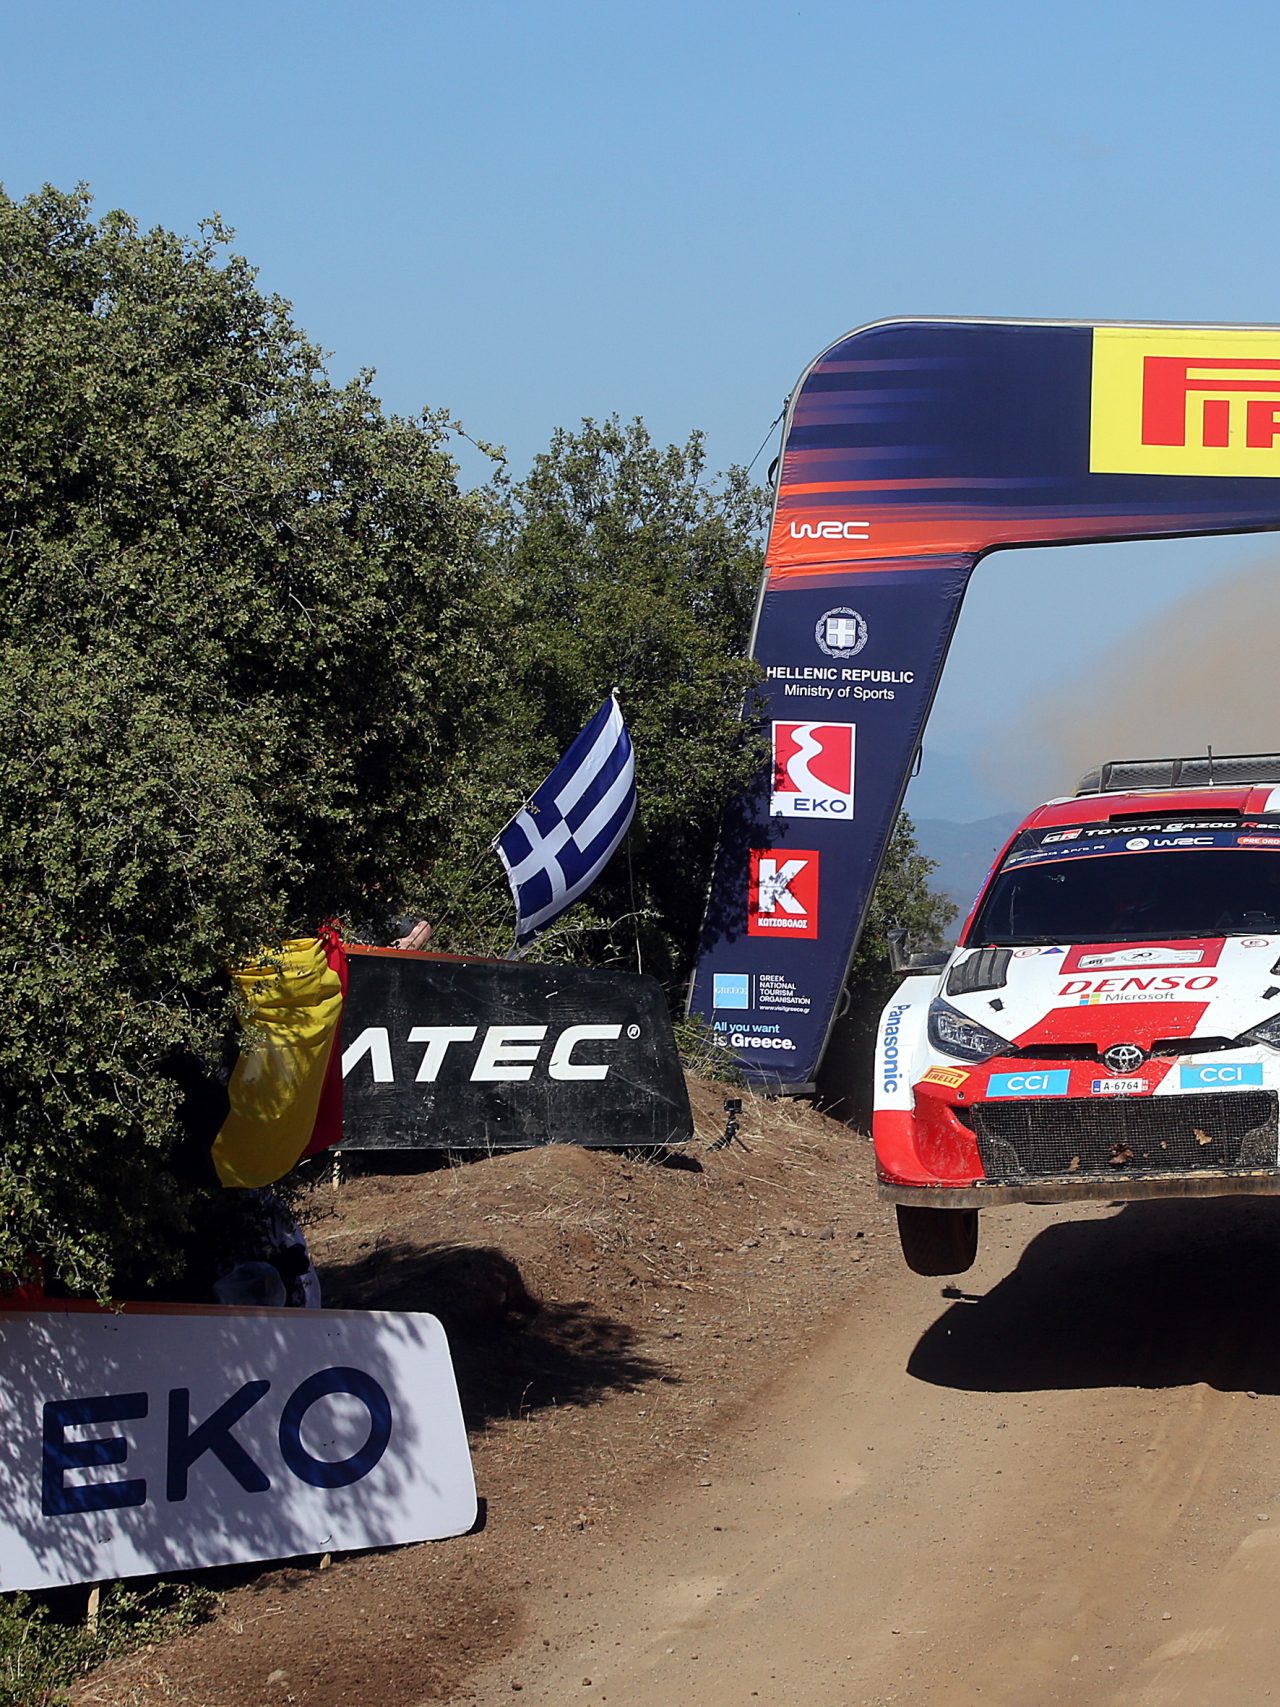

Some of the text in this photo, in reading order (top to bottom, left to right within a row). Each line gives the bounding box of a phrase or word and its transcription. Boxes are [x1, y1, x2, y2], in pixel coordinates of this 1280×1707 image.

[790, 521, 870, 539] WRC
[766, 666, 914, 683] HELLENIC REPUBLIC
[784, 684, 895, 701] Ministry of Sports
[793, 798, 847, 813] EKO
[1085, 825, 1161, 836] TOYOTA
[1162, 822, 1237, 833] GAZOO
[1153, 837, 1214, 847] WRC
[759, 974, 785, 982] GREEK
[759, 982, 797, 990] NATIONAL
[1058, 975, 1218, 996] DENSO
[759, 996, 811, 1005] ORGANISATION
[1105, 992, 1175, 1001] Microsoft
[759, 1005, 811, 1014] www.visitgreece.gr
[713, 1021, 780, 1034] All you want
[731, 1033, 796, 1050] Greece.
[883, 1004, 911, 1093] Panasonic
[924, 1067, 964, 1085] PIRELLI
[1103, 1081, 1139, 1091] A-6764
[41, 1366, 392, 1516] EKO
